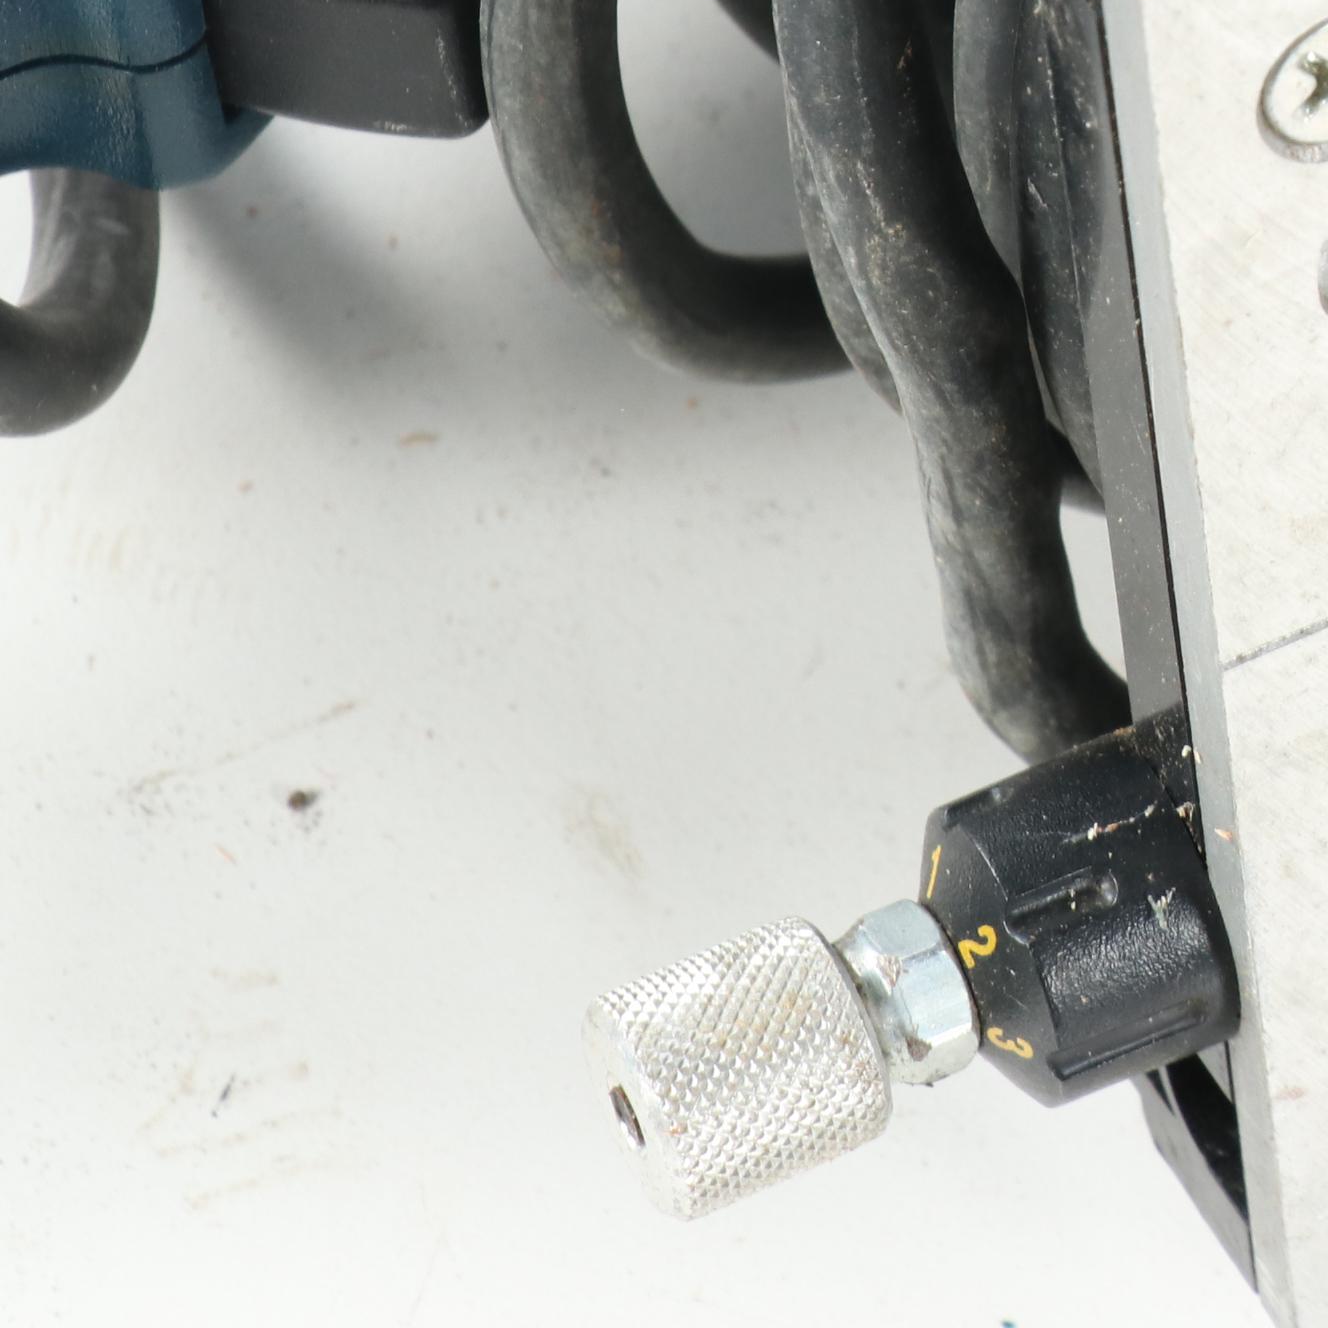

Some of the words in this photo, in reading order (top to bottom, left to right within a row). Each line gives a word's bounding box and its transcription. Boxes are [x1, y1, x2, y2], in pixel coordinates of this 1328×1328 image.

[927, 845, 941, 900] 1
[957, 924, 998, 968] 2
[986, 1025, 1034, 1060] 3
